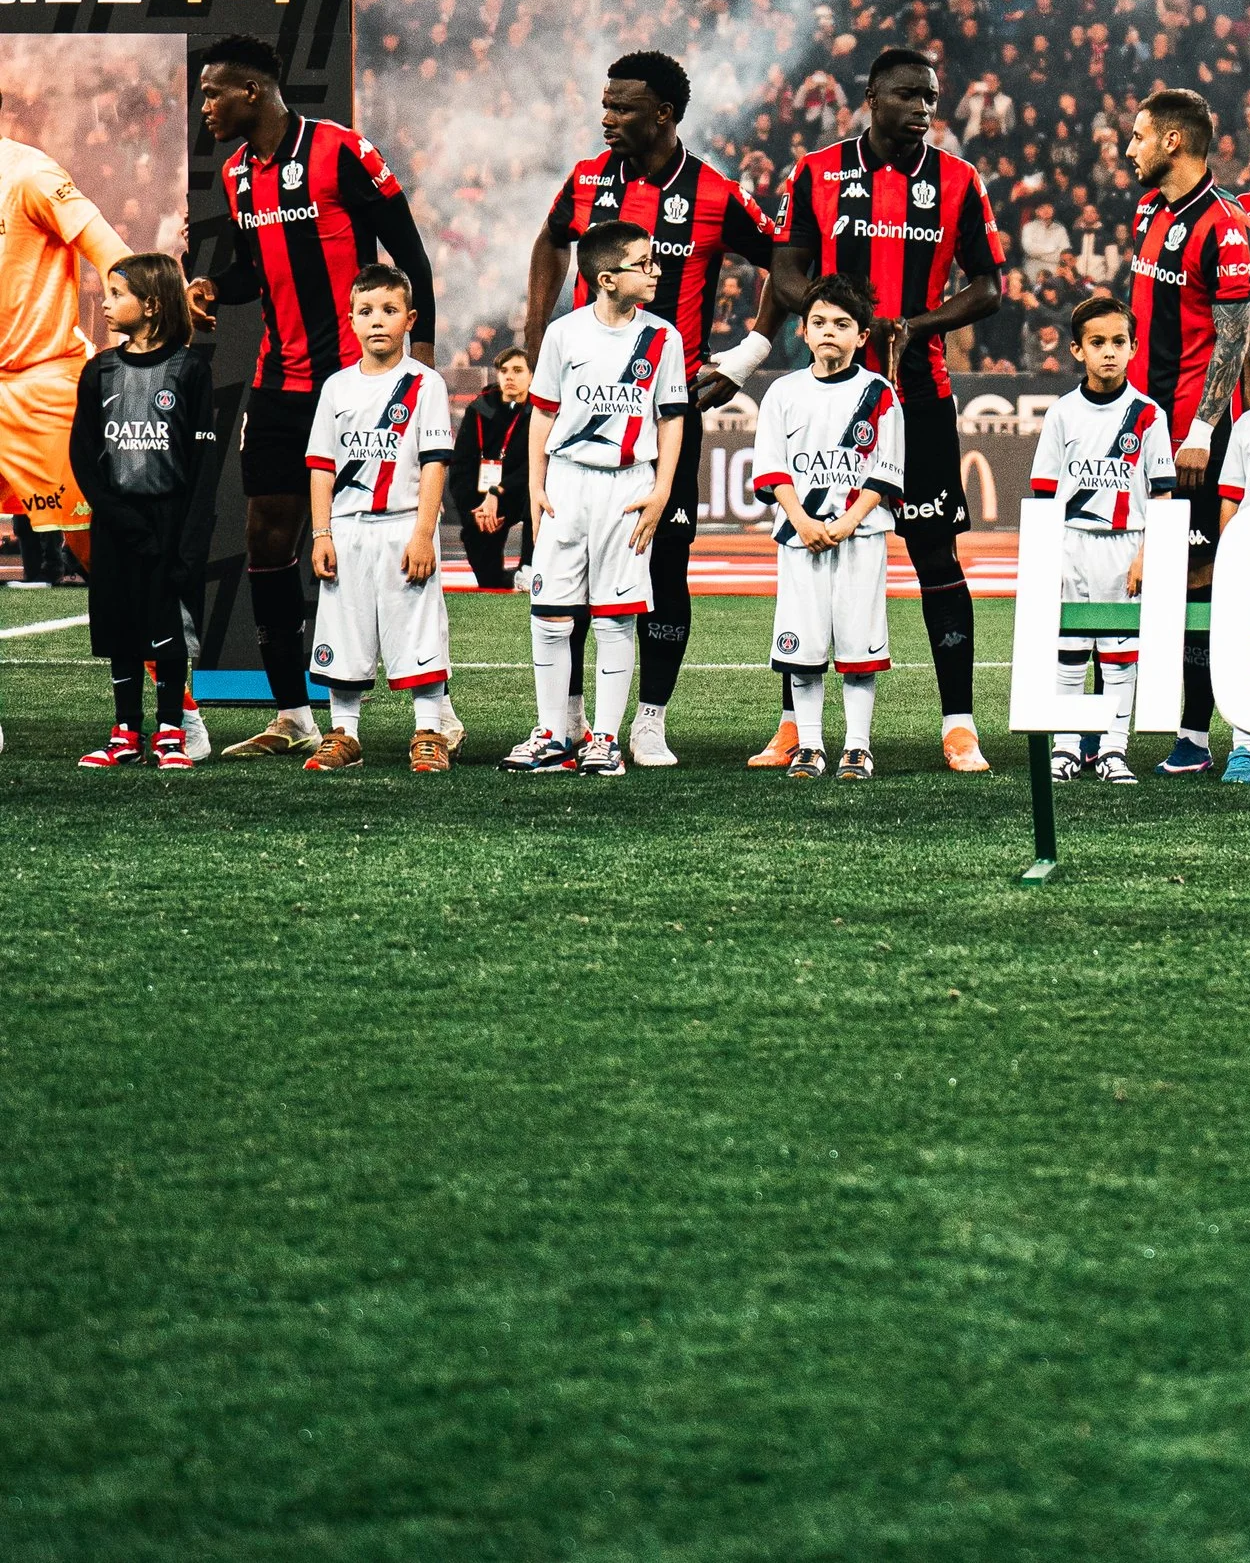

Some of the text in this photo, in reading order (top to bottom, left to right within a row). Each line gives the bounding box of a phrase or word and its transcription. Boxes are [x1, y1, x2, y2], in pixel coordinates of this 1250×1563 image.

[579, 174, 615, 186] actual
[823, 167, 862, 181] actual
[244, 201, 319, 229] Robinhood
[854, 220, 944, 243] Robinhood
[1131, 254, 1187, 287] Robinhood
[576, 385, 642, 404] QATAR
[592, 402, 642, 415] AIRWAYS
[104, 421, 169, 440] QATAR
[117, 439, 169, 451] AIRWAYS
[340, 432, 398, 448] QATAR
[348, 448, 397, 461] AIRWAYS
[1068, 459, 1131, 478] QATAR
[1078, 477, 1130, 491] AIRWAYS
[22, 493, 63, 512] vbet
[893, 497, 944, 520] vbet
[648, 622, 686, 634] OGC
[648, 630, 684, 642] NICE
